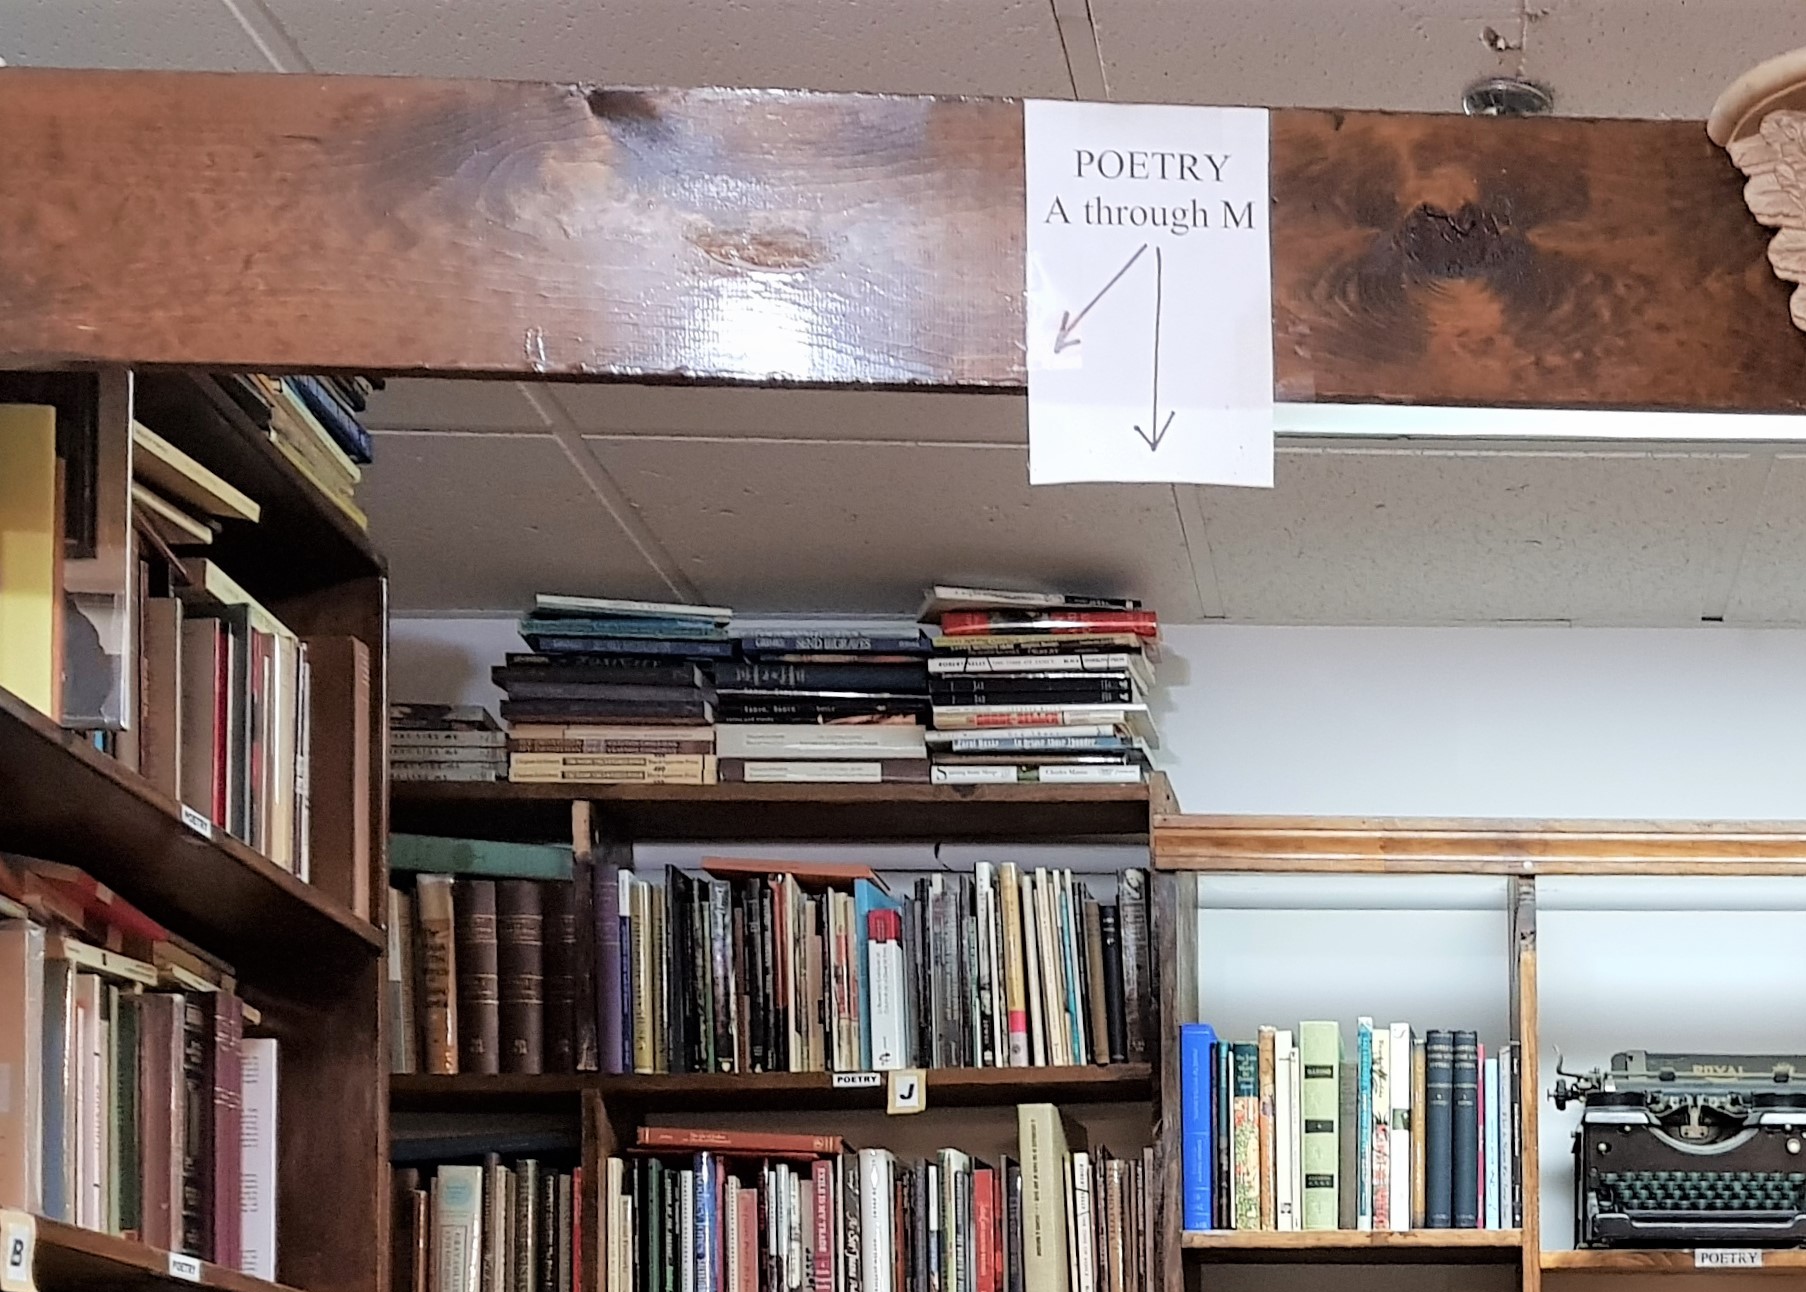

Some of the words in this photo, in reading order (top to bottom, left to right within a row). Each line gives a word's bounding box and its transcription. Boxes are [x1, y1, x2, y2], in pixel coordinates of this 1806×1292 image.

[1073, 148, 1231, 182] POETRY
[1043, 195, 1071, 226] A
[1084, 196, 1209, 236] through
[1221, 200, 1256, 230] M
[837, 1075, 877, 1083] POETRY
[899, 1083, 914, 1100] J
[1700, 1252, 1759, 1265] POETRY
